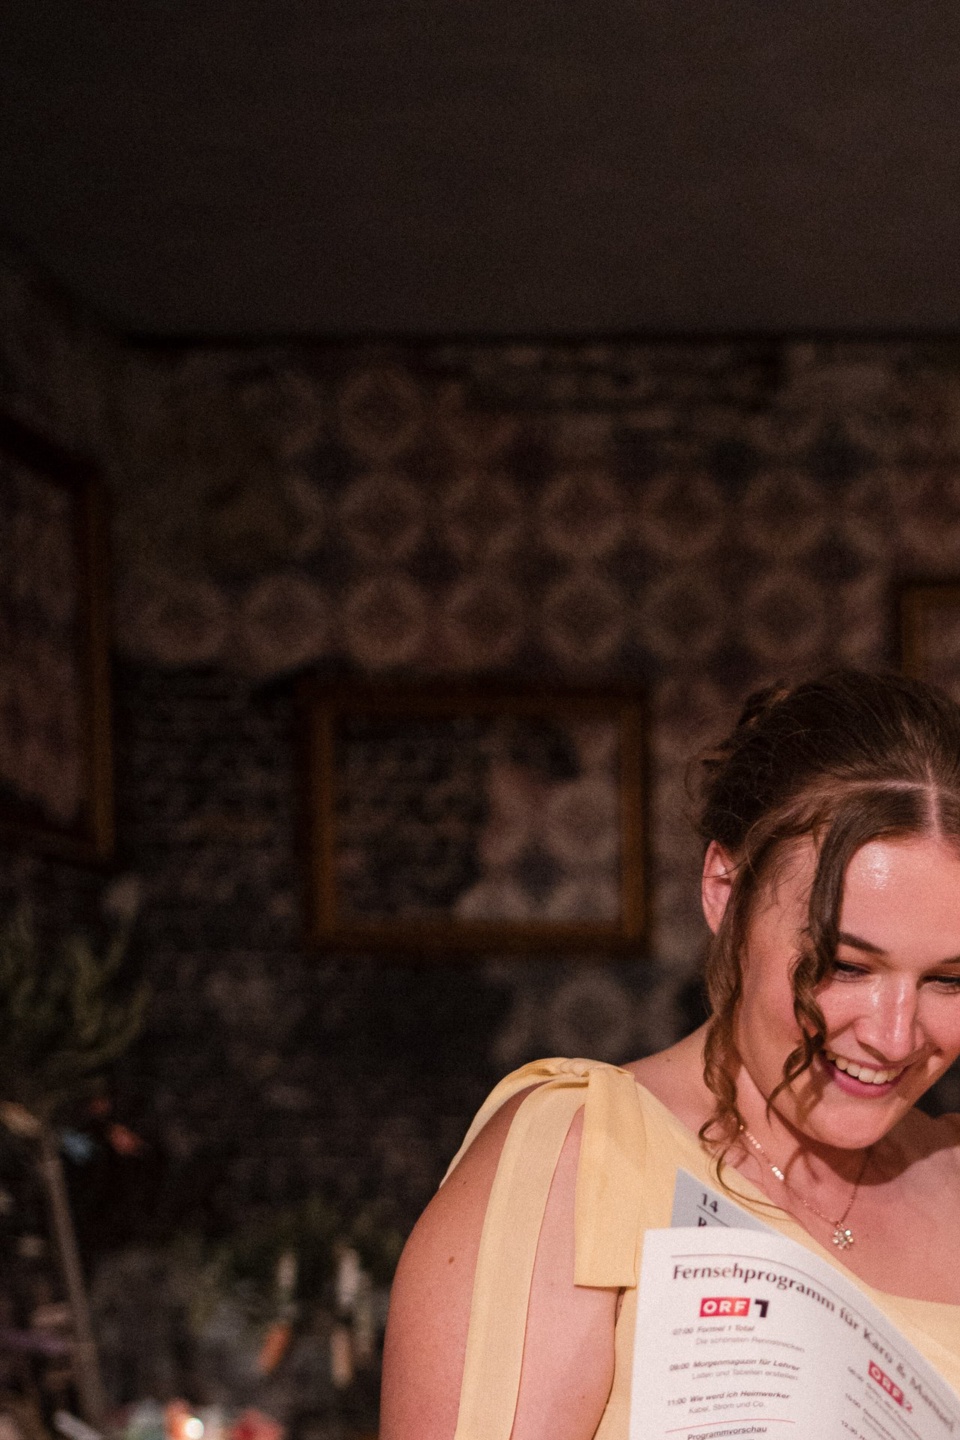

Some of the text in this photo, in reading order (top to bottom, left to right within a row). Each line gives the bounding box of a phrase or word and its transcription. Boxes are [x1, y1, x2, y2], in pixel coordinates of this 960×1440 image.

[702, 1193, 719, 1213] 14
[673, 1263, 836, 1312] Fernsehprogramm
[840, 1307, 859, 1331] für
[863, 1328, 893, 1363] Karo
[701, 1299, 769, 1318] ORF 1
[759, 1358, 771, 1366] für
[868, 1361, 904, 1405] ORF
[726, 1391, 739, 1399] ich
[740, 1390, 791, 1400] Heimwerker
[713, 1402, 735, 1412] Strom
[736, 1401, 751, 1409] und
